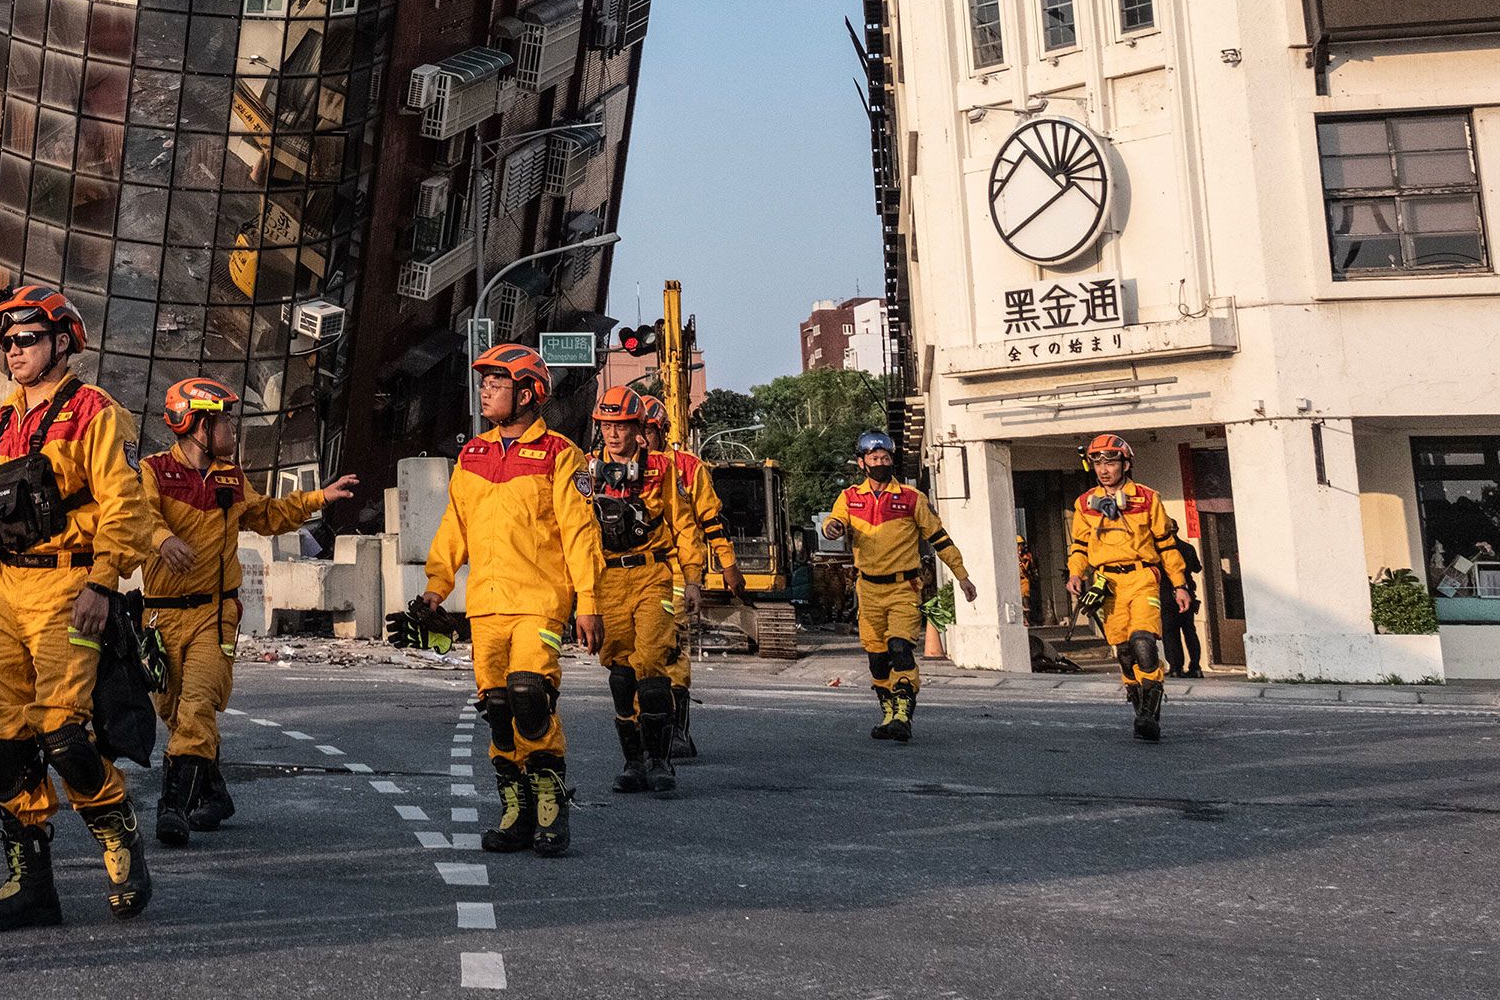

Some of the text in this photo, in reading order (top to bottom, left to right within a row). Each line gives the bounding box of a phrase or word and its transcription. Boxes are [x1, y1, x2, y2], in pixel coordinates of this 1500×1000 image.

[1003, 279, 1120, 335] 黑金通
[547, 337, 588, 350] 中山路
[1008, 334, 1122, 362] 全ての始まり
